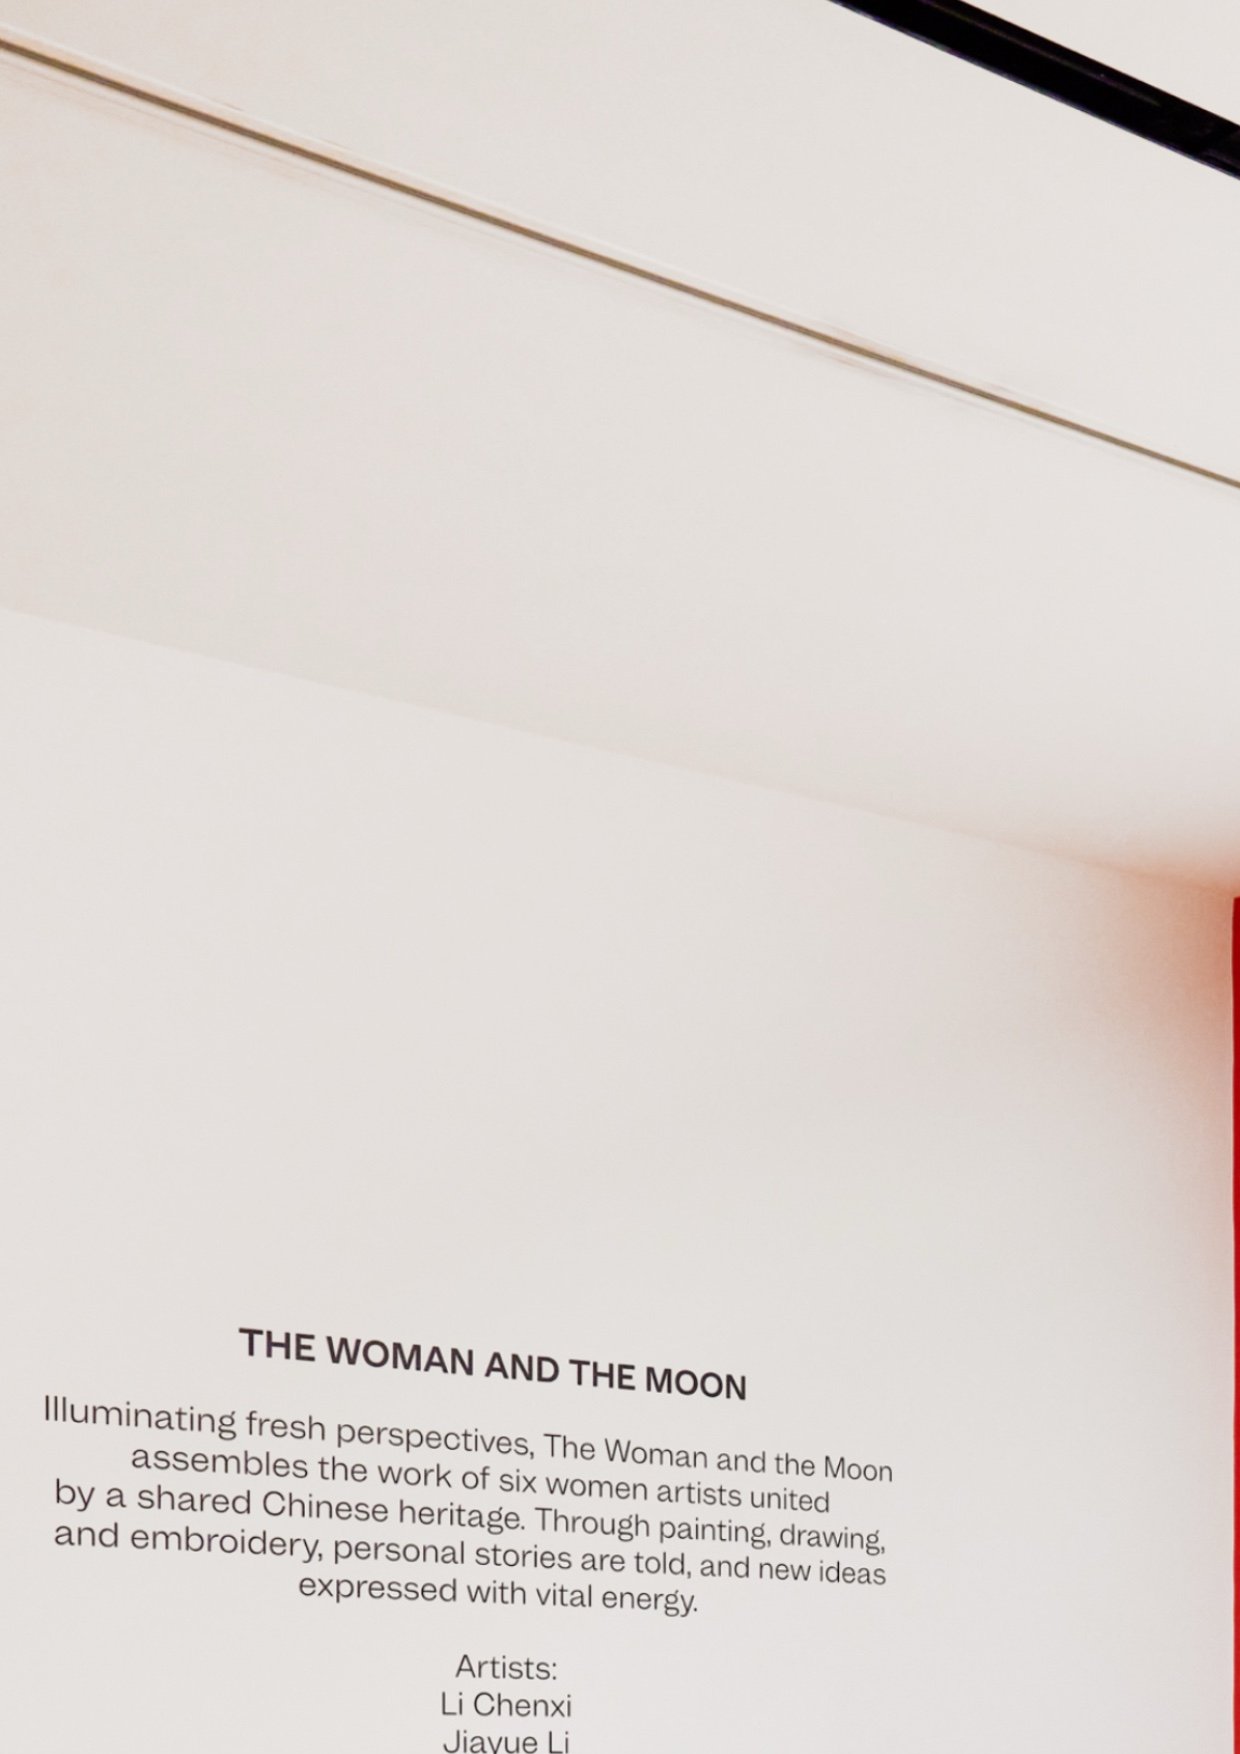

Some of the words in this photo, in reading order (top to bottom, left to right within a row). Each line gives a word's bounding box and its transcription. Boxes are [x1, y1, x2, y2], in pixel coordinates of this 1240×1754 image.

[237, 1326, 316, 1363] THE
[325, 1335, 474, 1377] WOMAN
[483, 1351, 560, 1384] AND
[568, 1358, 637, 1392] THE
[645, 1365, 747, 1402] MOON
[44, 1394, 238, 1442] Illuminating
[245, 1409, 326, 1441] fresh
[336, 1423, 535, 1461] perspectives,
[542, 1432, 596, 1461] The
[604, 1437, 708, 1469] Woman
[716, 1450, 766, 1474] and
[774, 1452, 816, 1478] the
[824, 1454, 893, 1483] Moon
[131, 1448, 309, 1480] assembles
[317, 1455, 368, 1483] the
[377, 1462, 453, 1489] work
[461, 1465, 491, 1491] of
[498, 1468, 537, 1494] six
[545, 1476, 648, 1501] women
[656, 1480, 743, 1508] artists
[750, 1487, 830, 1514] united
[55, 1477, 96, 1513] by
[105, 1487, 128, 1509] a
[137, 1483, 251, 1515] shared
[262, 1490, 389, 1523] Chinese
[399, 1498, 526, 1536] heritage.
[533, 1506, 650, 1543] Through
[659, 1516, 772, 1551] painting,
[779, 1522, 886, 1557] drawing,
[54, 1521, 119, 1549] and
[130, 1525, 324, 1564] embroidery,
[334, 1539, 465, 1565] personal
[474, 1543, 573, 1571] stories
[580, 1552, 626, 1573] are
[633, 1551, 692, 1580] told,
[699, 1555, 750, 1579] and
[758, 1561, 812, 1582] new
[819, 1559, 887, 1586] ideas
[298, 1576, 458, 1604] expressed
[466, 1579, 527, 1606] with
[535, 1581, 593, 1608] vital
[601, 1589, 698, 1618] energy.
[454, 1653, 557, 1681] Artists:
[441, 1690, 464, 1717] Li
[473, 1691, 572, 1718] Chenxi
[548, 1730, 570, 1754] Li
